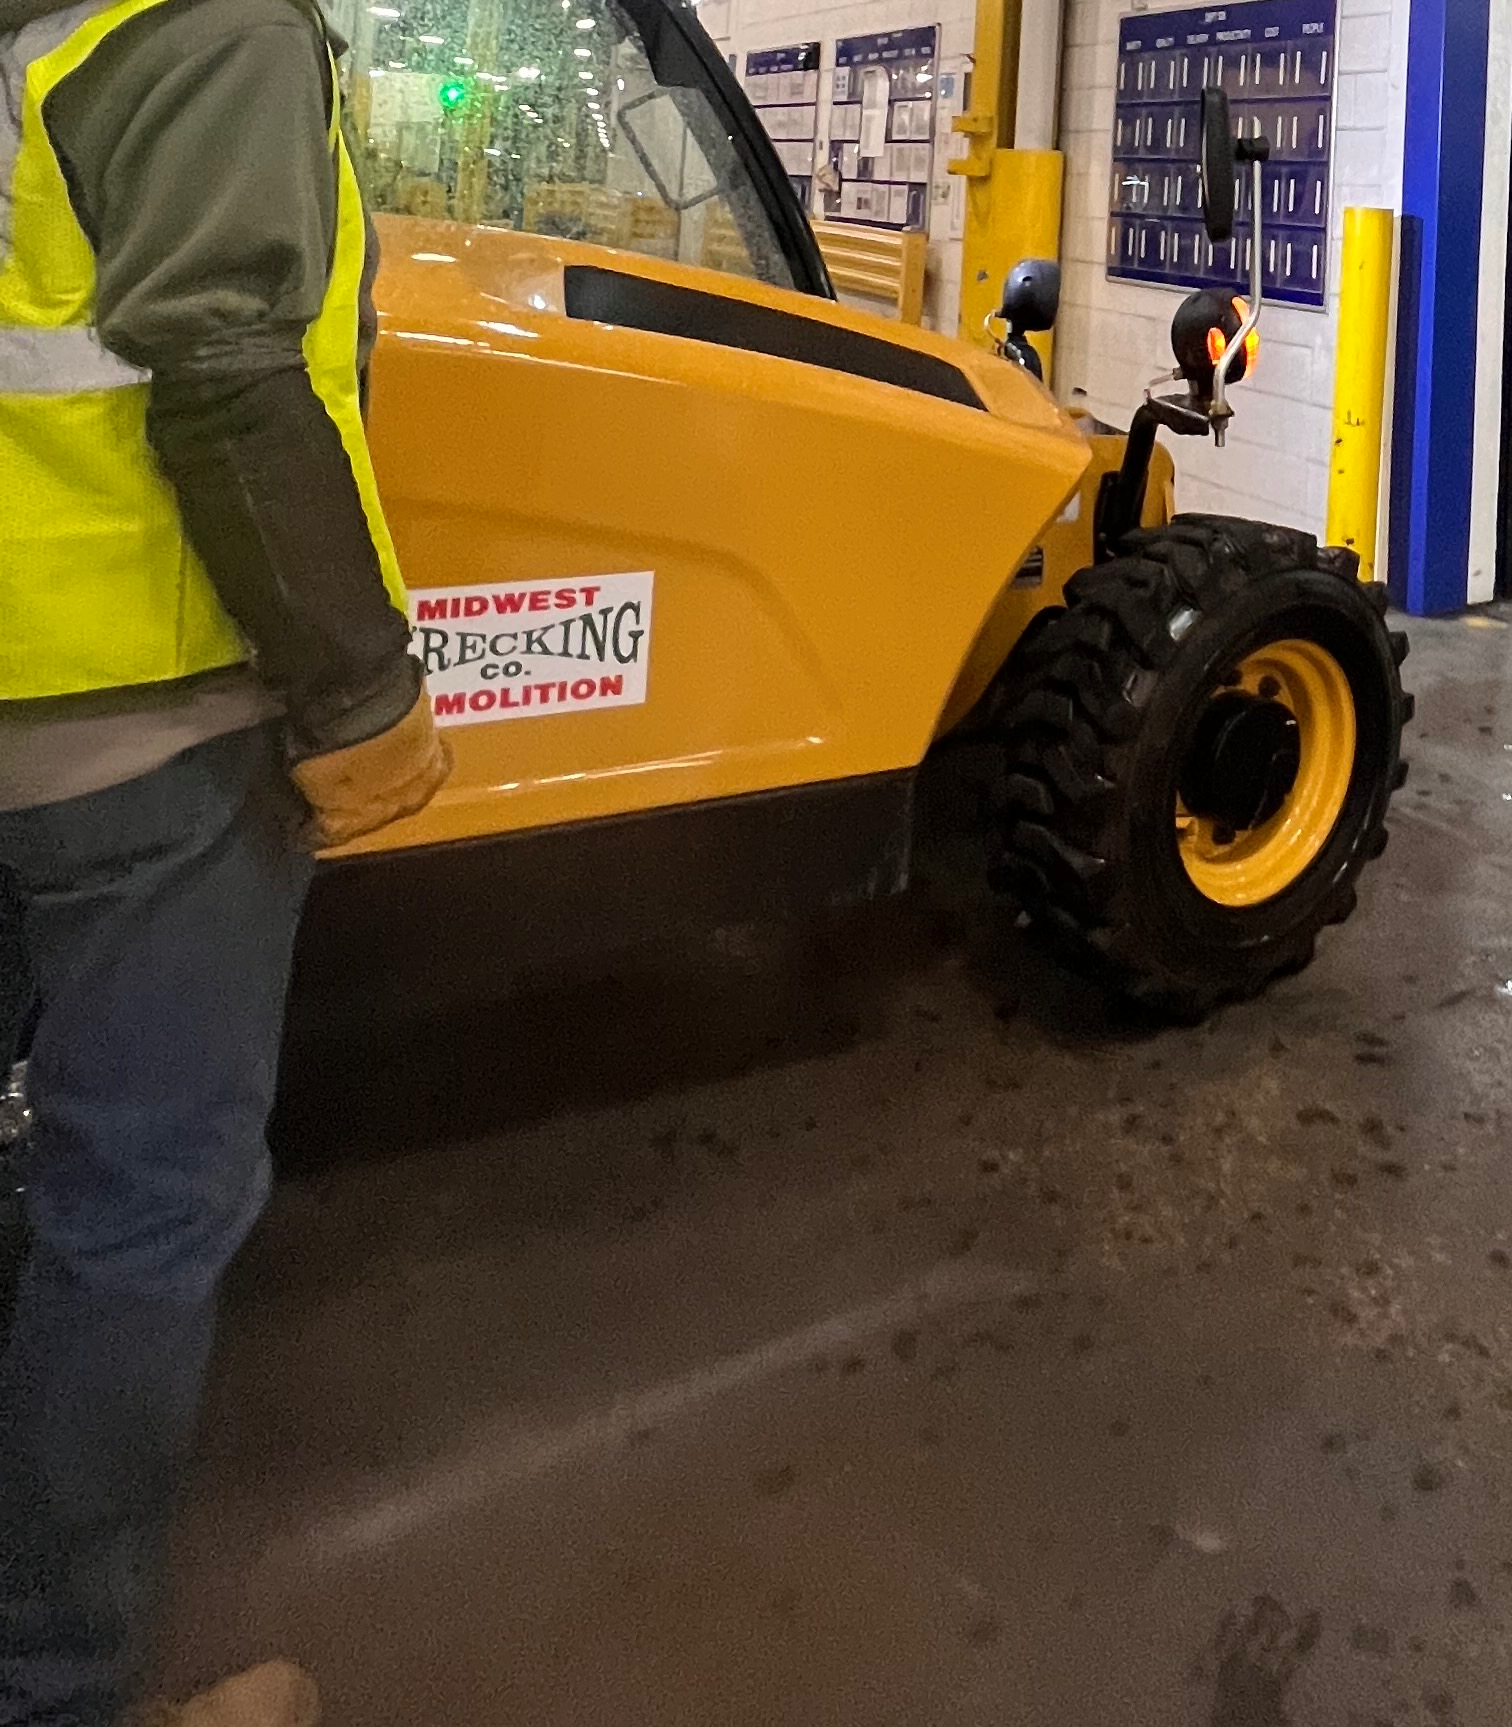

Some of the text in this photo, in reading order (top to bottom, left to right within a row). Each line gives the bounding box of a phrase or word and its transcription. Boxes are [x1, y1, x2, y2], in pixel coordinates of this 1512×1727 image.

[416, 585, 602, 622] MIDWEST
[412, 600, 645, 675] RECKING
[480, 659, 532, 681] CO.
[433, 674, 624, 716] MOLITION
